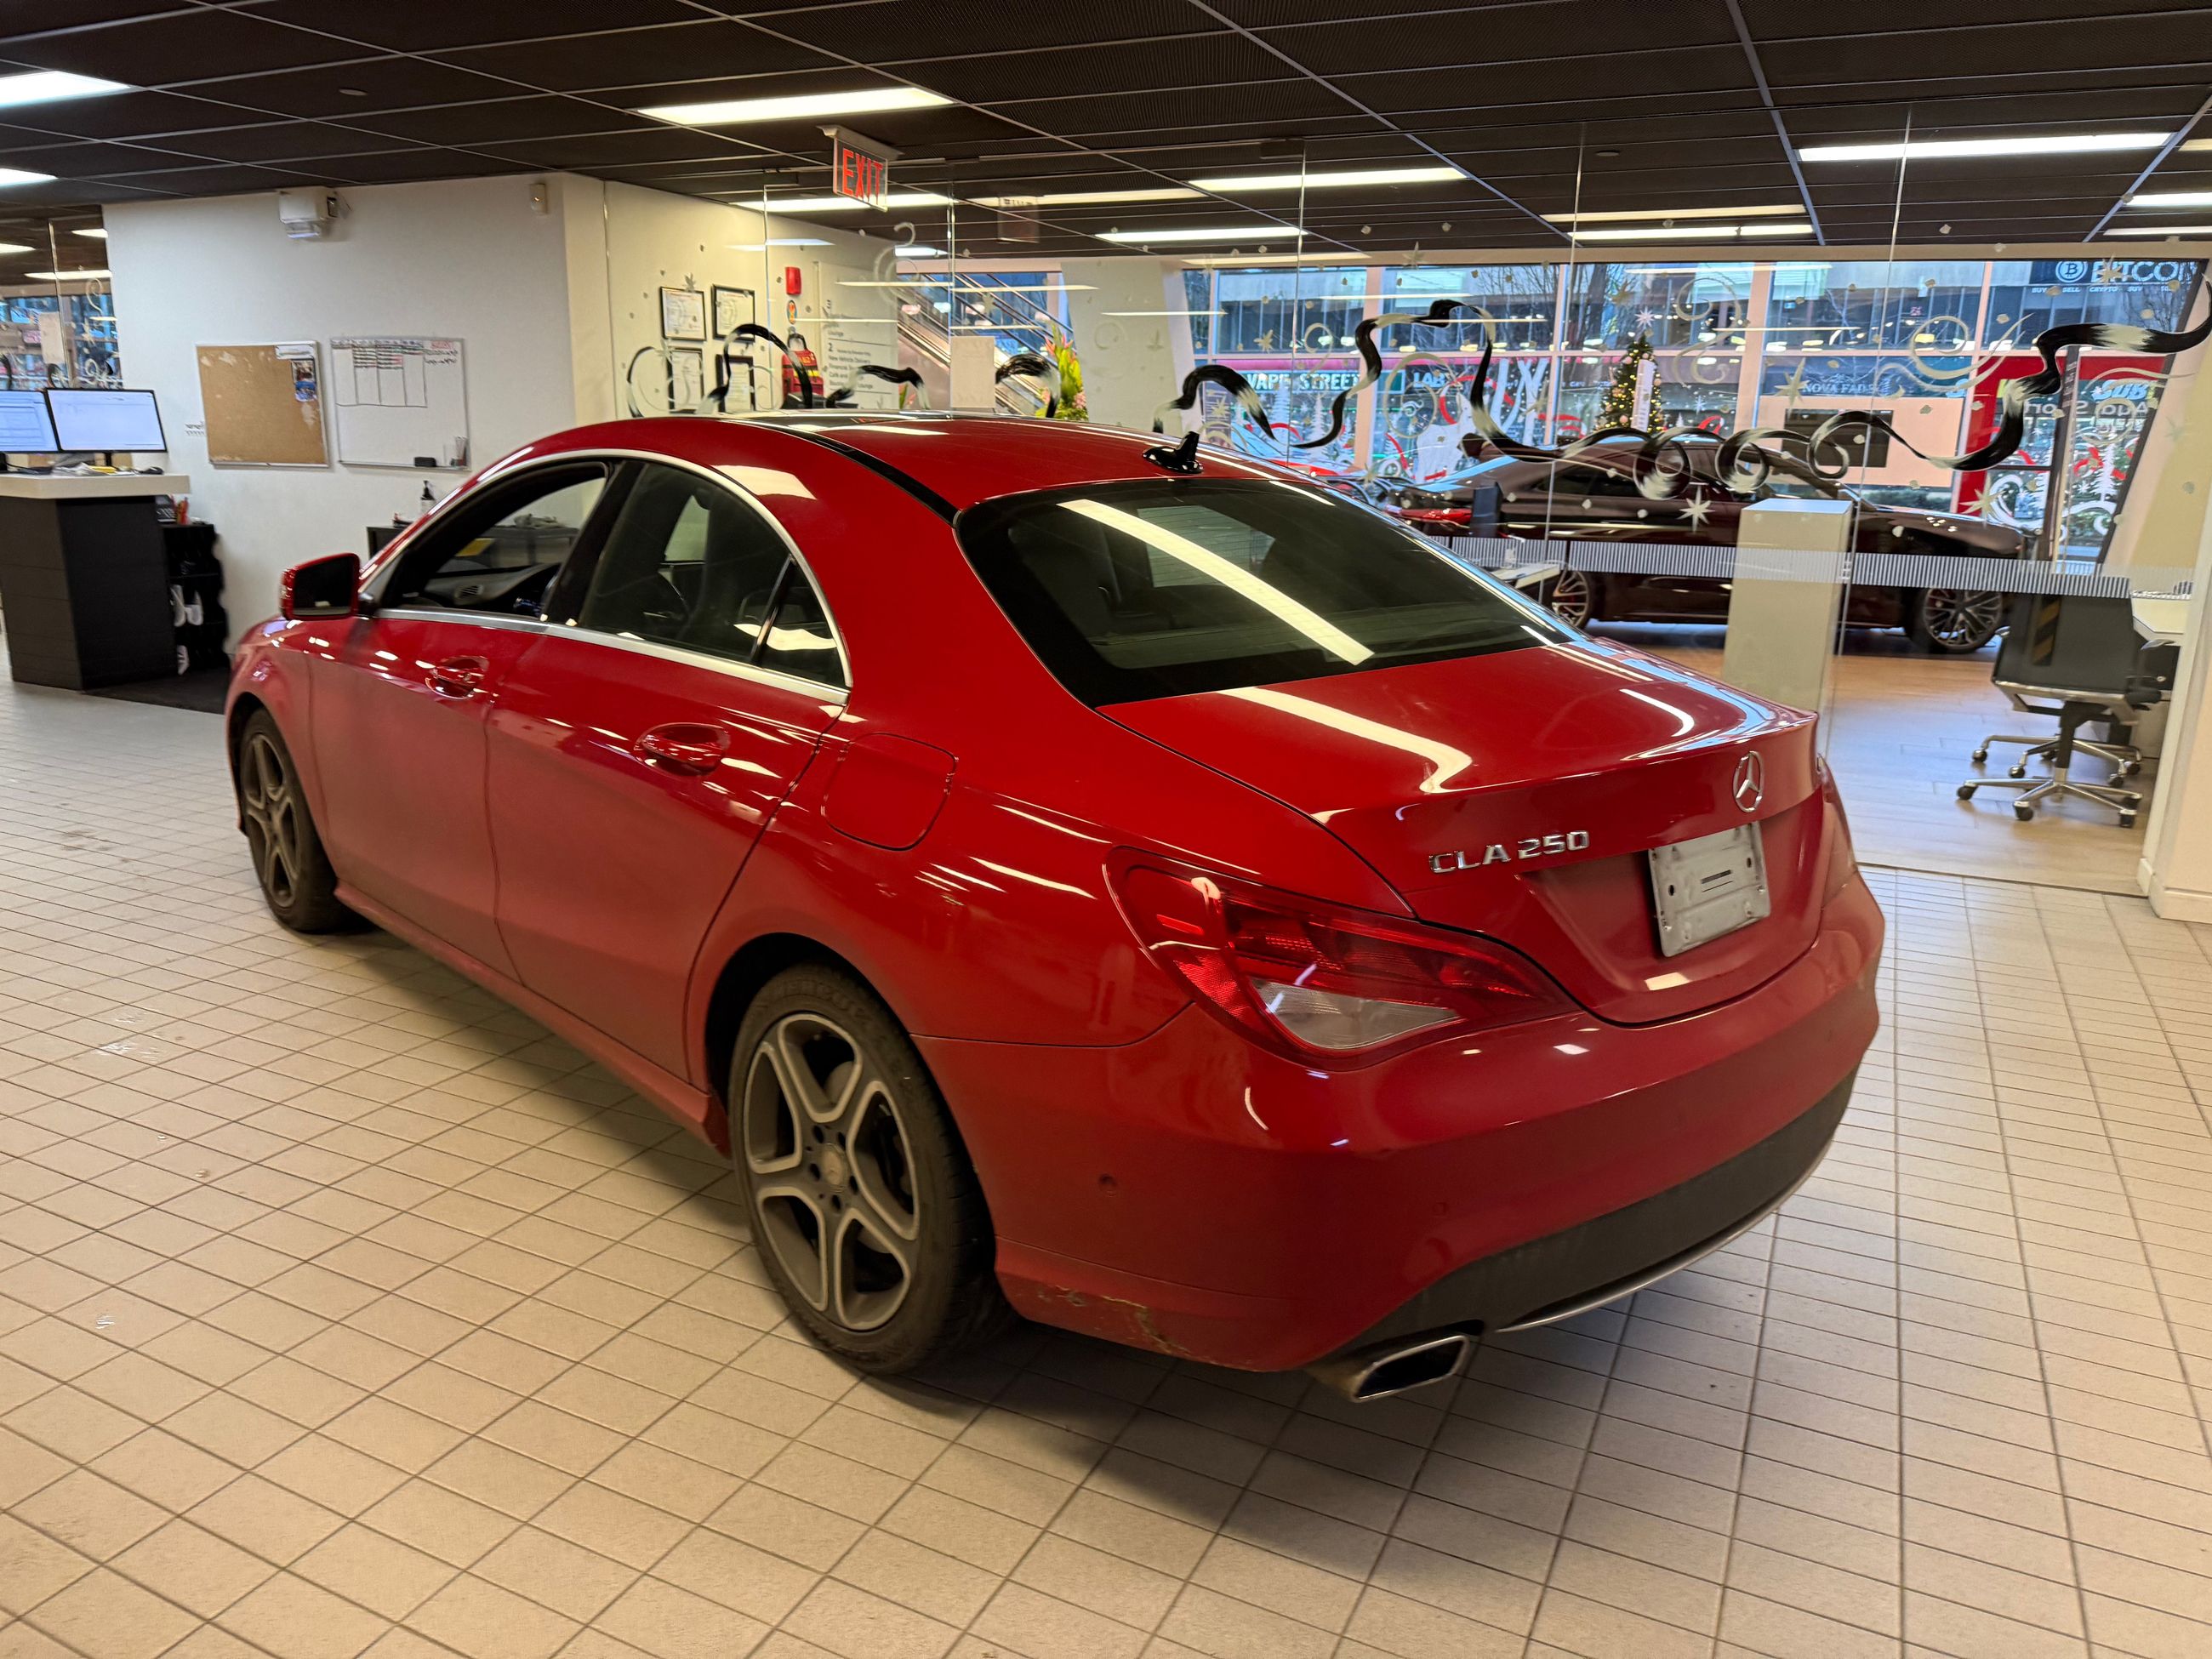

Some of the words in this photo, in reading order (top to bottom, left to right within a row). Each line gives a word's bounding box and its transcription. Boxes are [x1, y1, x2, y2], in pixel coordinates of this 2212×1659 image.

[842, 147, 884, 205] EXIT
[1428, 844, 1512, 874] CLA
[1517, 830, 1590, 859] 250
